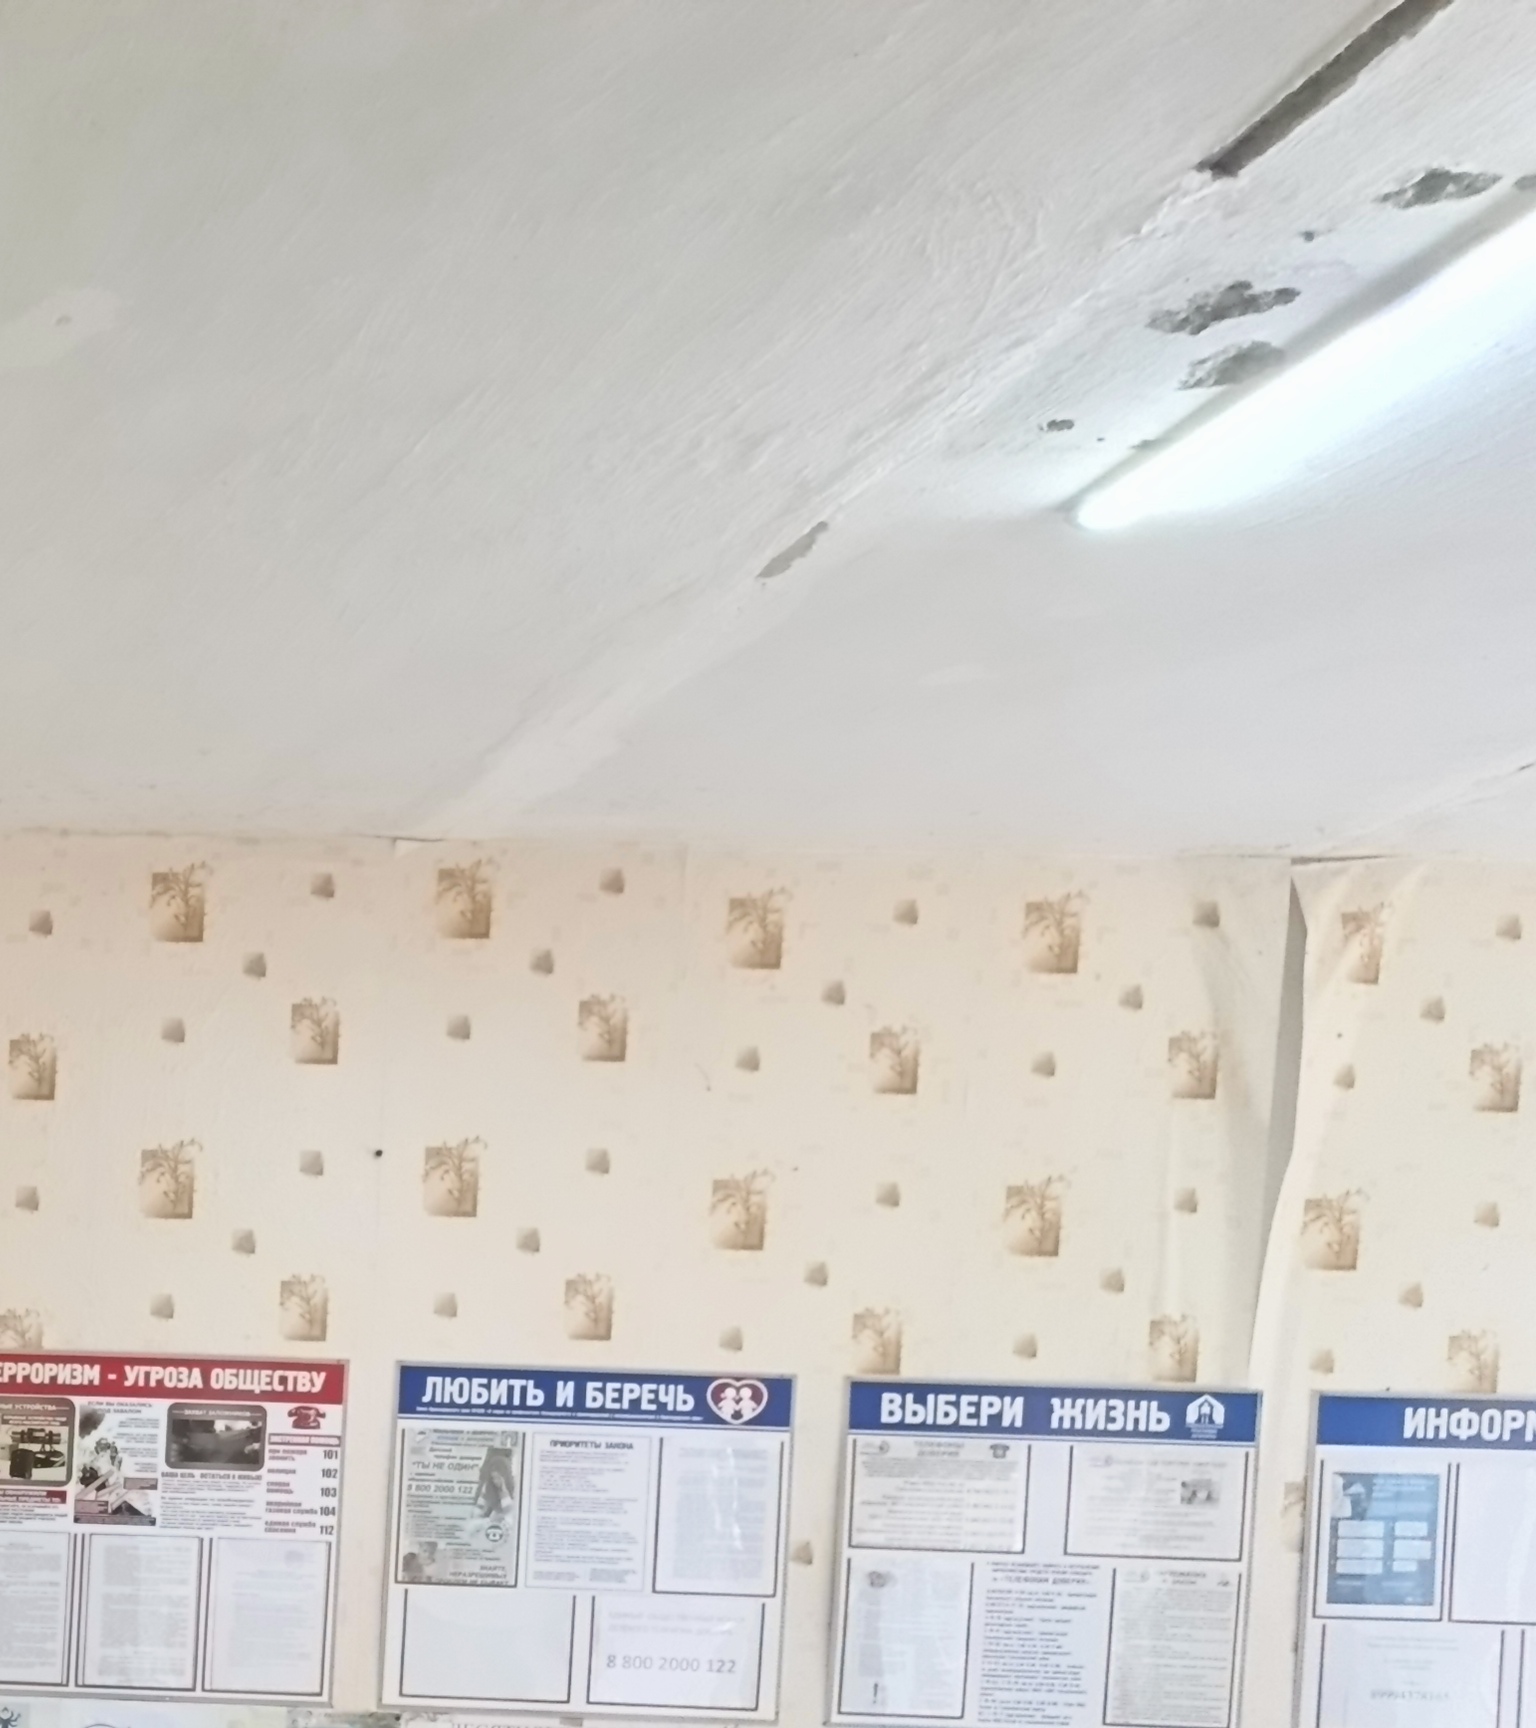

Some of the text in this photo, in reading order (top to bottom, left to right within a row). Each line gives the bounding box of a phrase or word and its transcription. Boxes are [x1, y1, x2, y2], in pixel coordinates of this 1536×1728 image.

[123, 1365, 203, 1389] УГРОЗА
[209, 1368, 327, 1395] ОБЩЕСТВУ
[422, 1376, 545, 1407] ЛЮБИТЬ
[555, 1379, 574, 1408] И
[585, 1381, 695, 1413] БЕРЕЧЬ
[880, 1391, 1171, 1432] ВЫБЕРИ ЖИЗНЬ
[323, 1449, 338, 1460] 101
[321, 1468, 338, 1479] 102
[320, 1487, 337, 1498] 103
[414, 1484, 432, 1493] 800
[433, 1485, 456, 1494] 2000
[458, 1485, 474, 1494] 122
[319, 1506, 336, 1517] 104
[319, 1525, 334, 1536] 112
[606, 1654, 737, 1674] 8 800 2000 122
